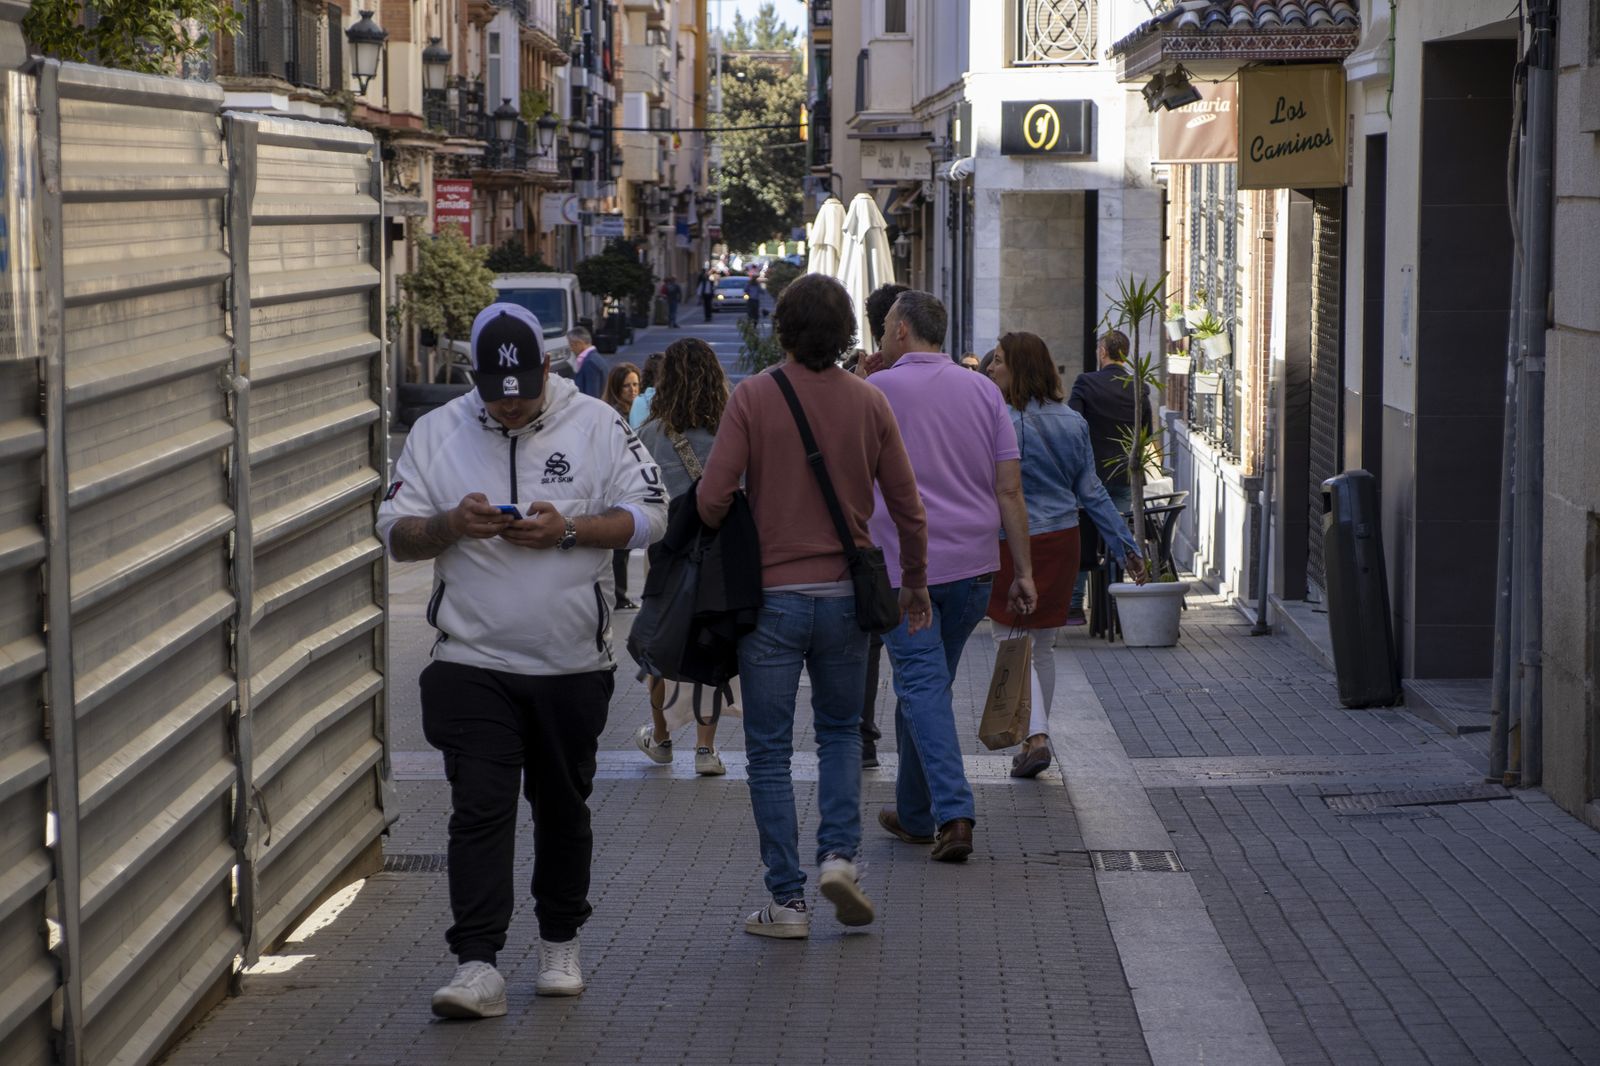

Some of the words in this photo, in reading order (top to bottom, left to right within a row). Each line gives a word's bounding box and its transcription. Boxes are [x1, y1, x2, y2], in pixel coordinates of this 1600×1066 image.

[1169, 97, 1231, 113] anaria
[1270, 96, 1308, 124] Los
[1250, 128, 1334, 162] Caminos
[498, 342, 519, 367] NY
